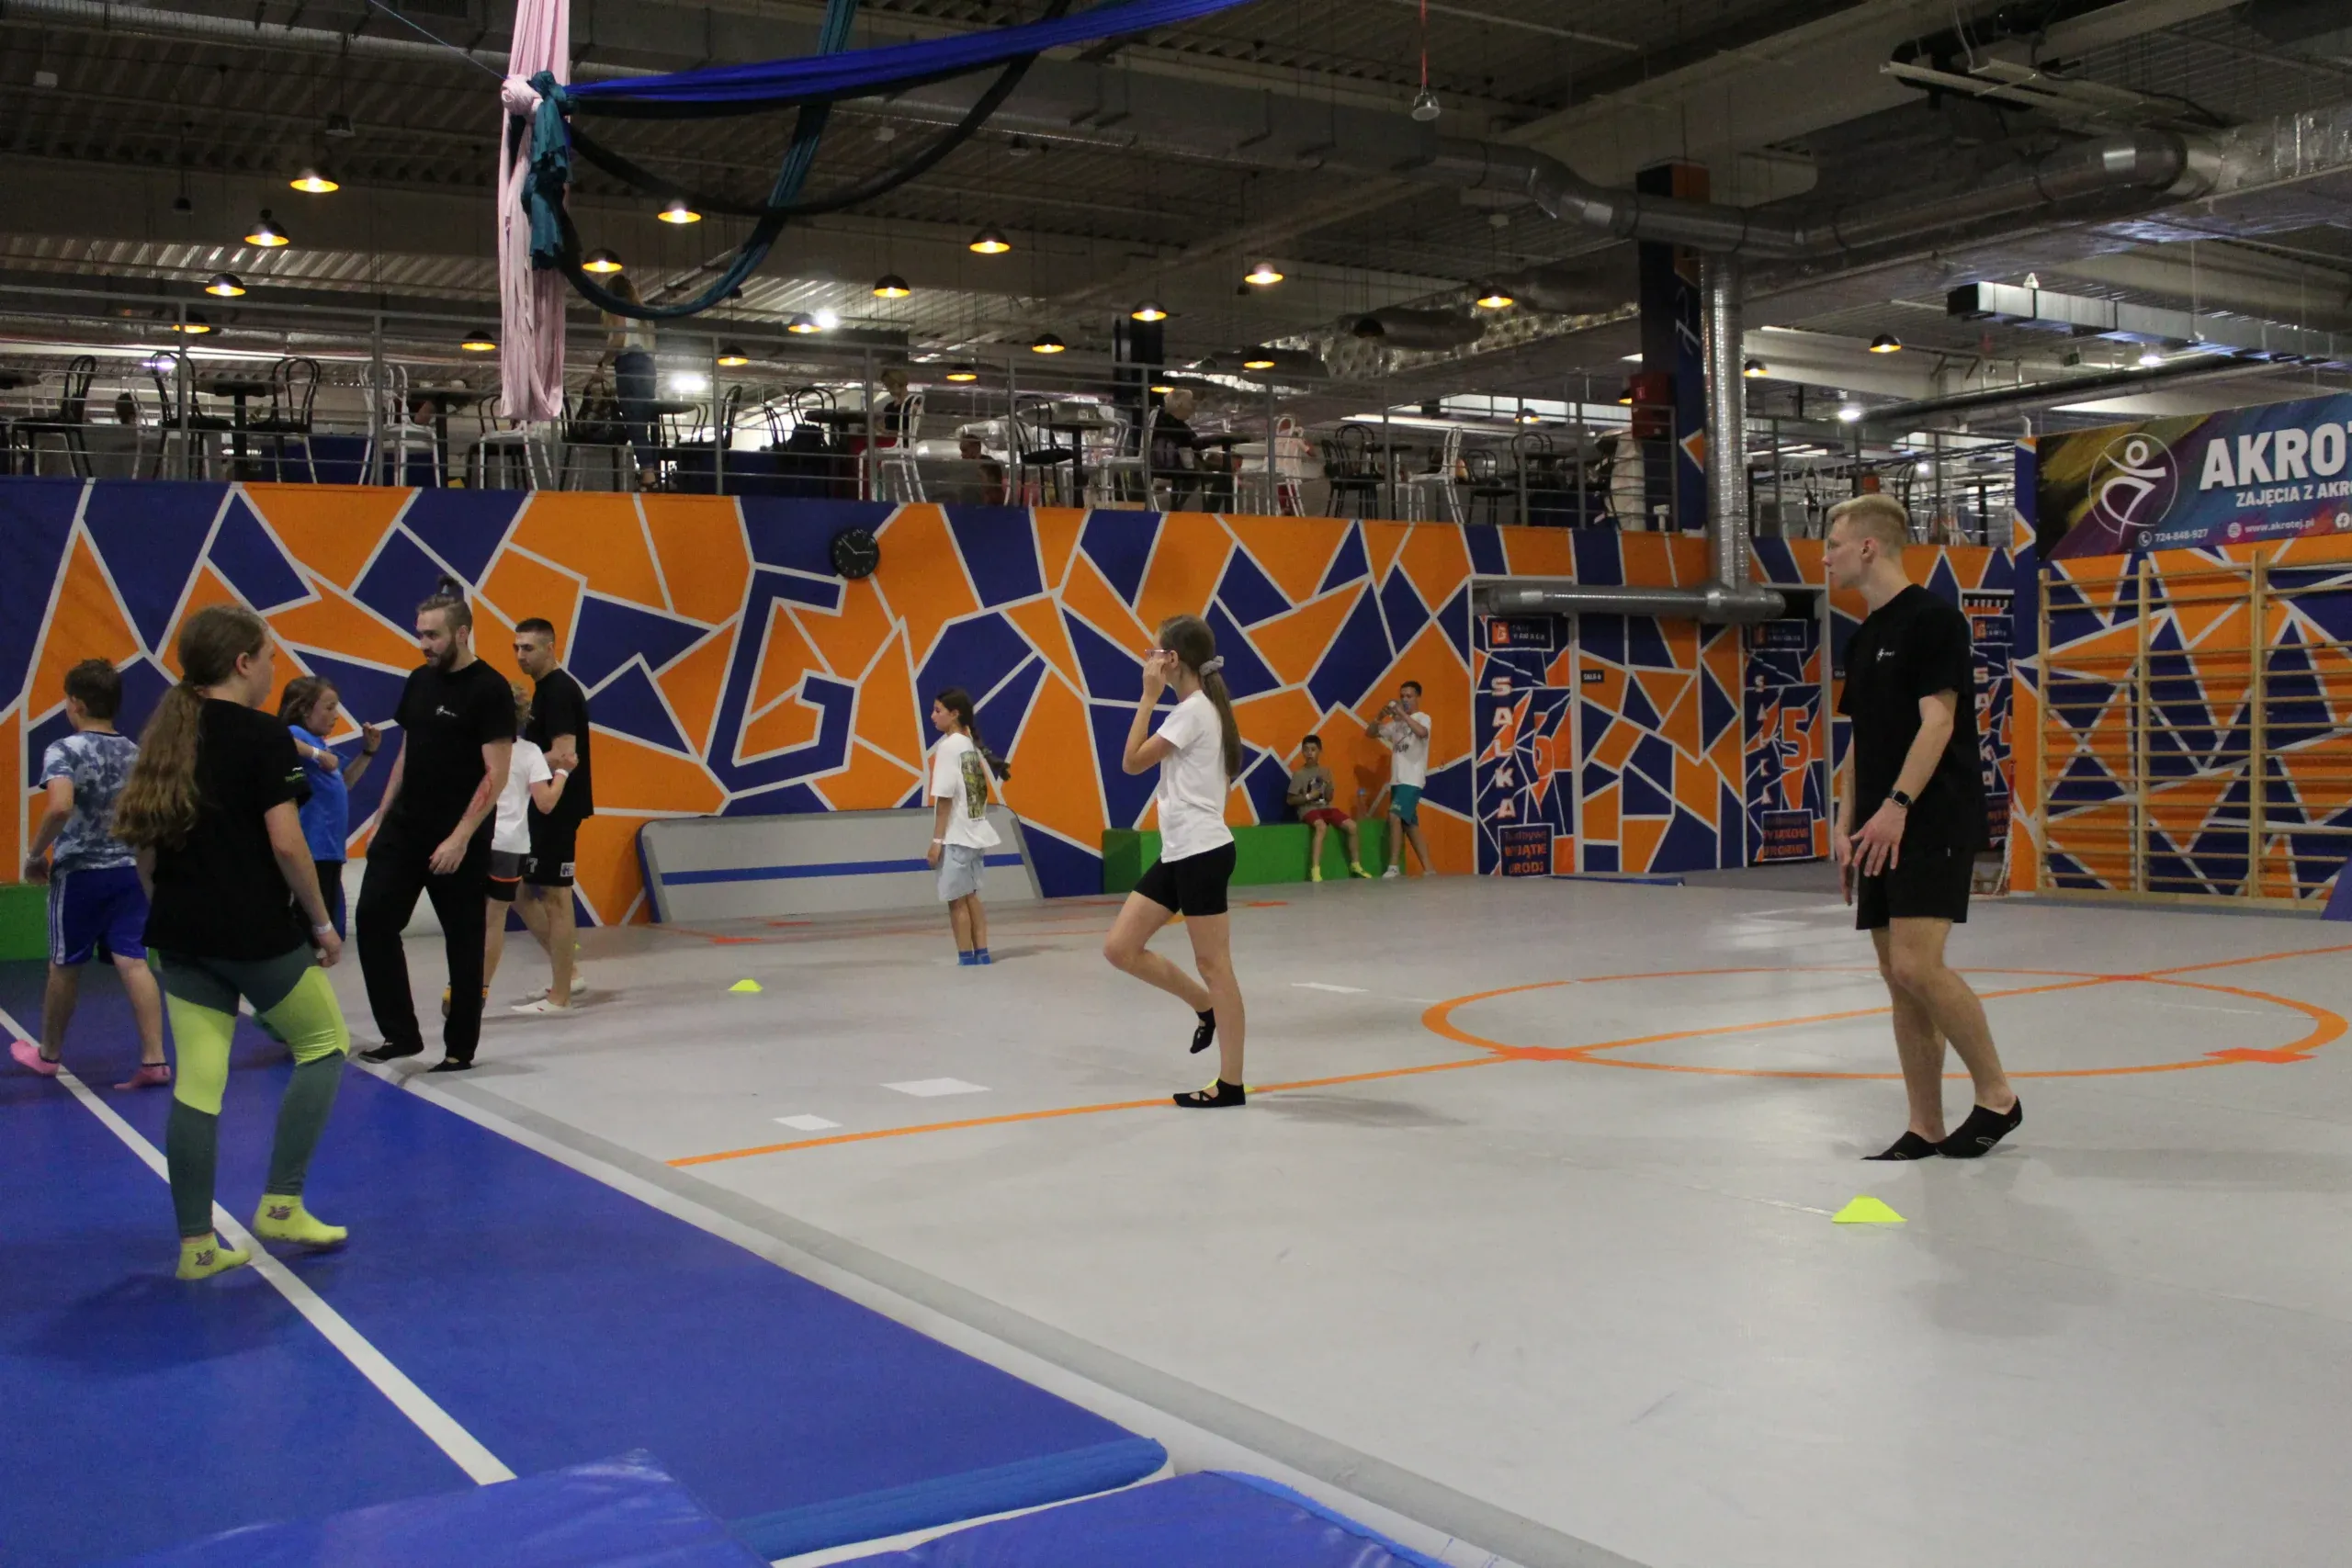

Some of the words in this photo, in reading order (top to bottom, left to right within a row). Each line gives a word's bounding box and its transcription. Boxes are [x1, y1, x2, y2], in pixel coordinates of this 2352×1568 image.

[2199, 420, 2352, 491] AKRO
[2235, 486, 2300, 508] ZAJĘCIA
[2302, 484, 2314, 500] Z
[2244, 517, 2315, 534] www.akrotej.pl
[1490, 676, 1516, 818] SALKA
